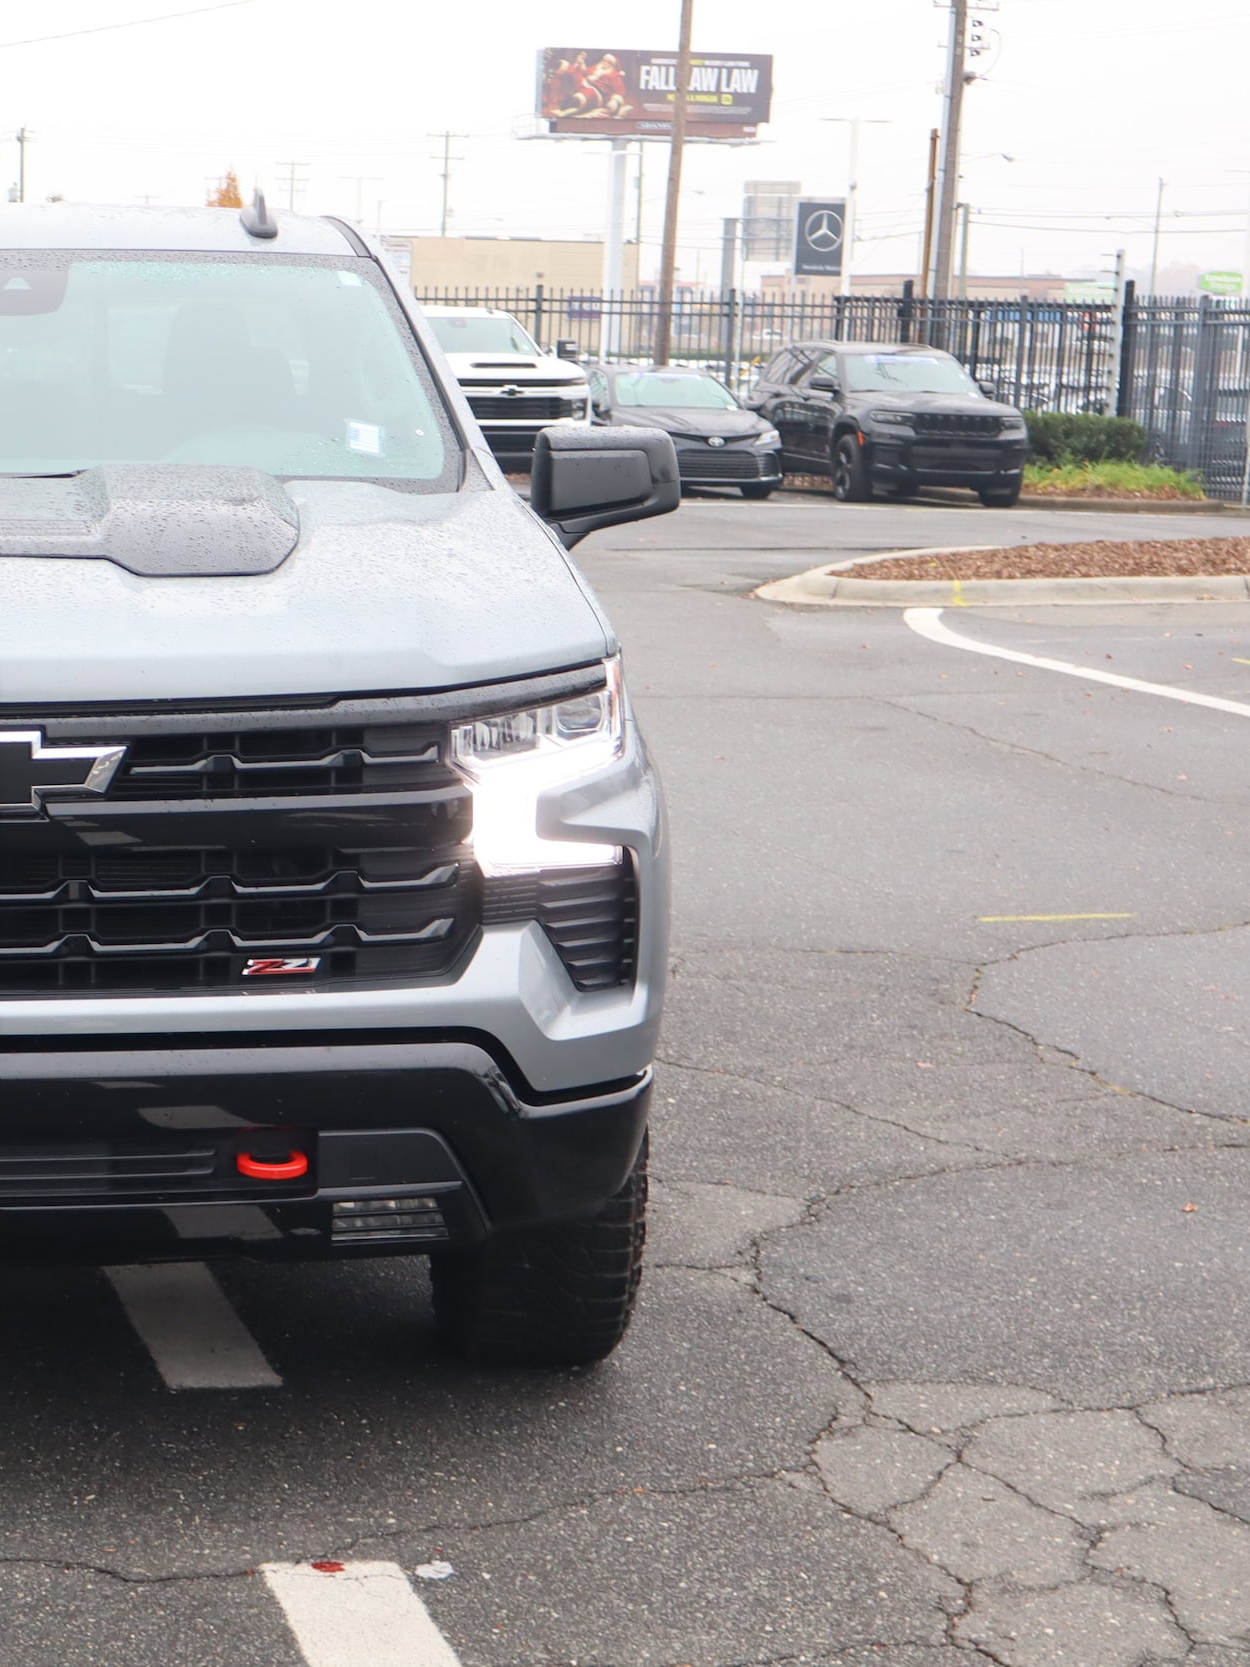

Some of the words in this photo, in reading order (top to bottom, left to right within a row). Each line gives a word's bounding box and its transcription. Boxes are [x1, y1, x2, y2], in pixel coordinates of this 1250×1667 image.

[639, 65, 677, 91] FALL
[720, 67, 759, 94] LAW
[241, 957, 321, 976] Z71
